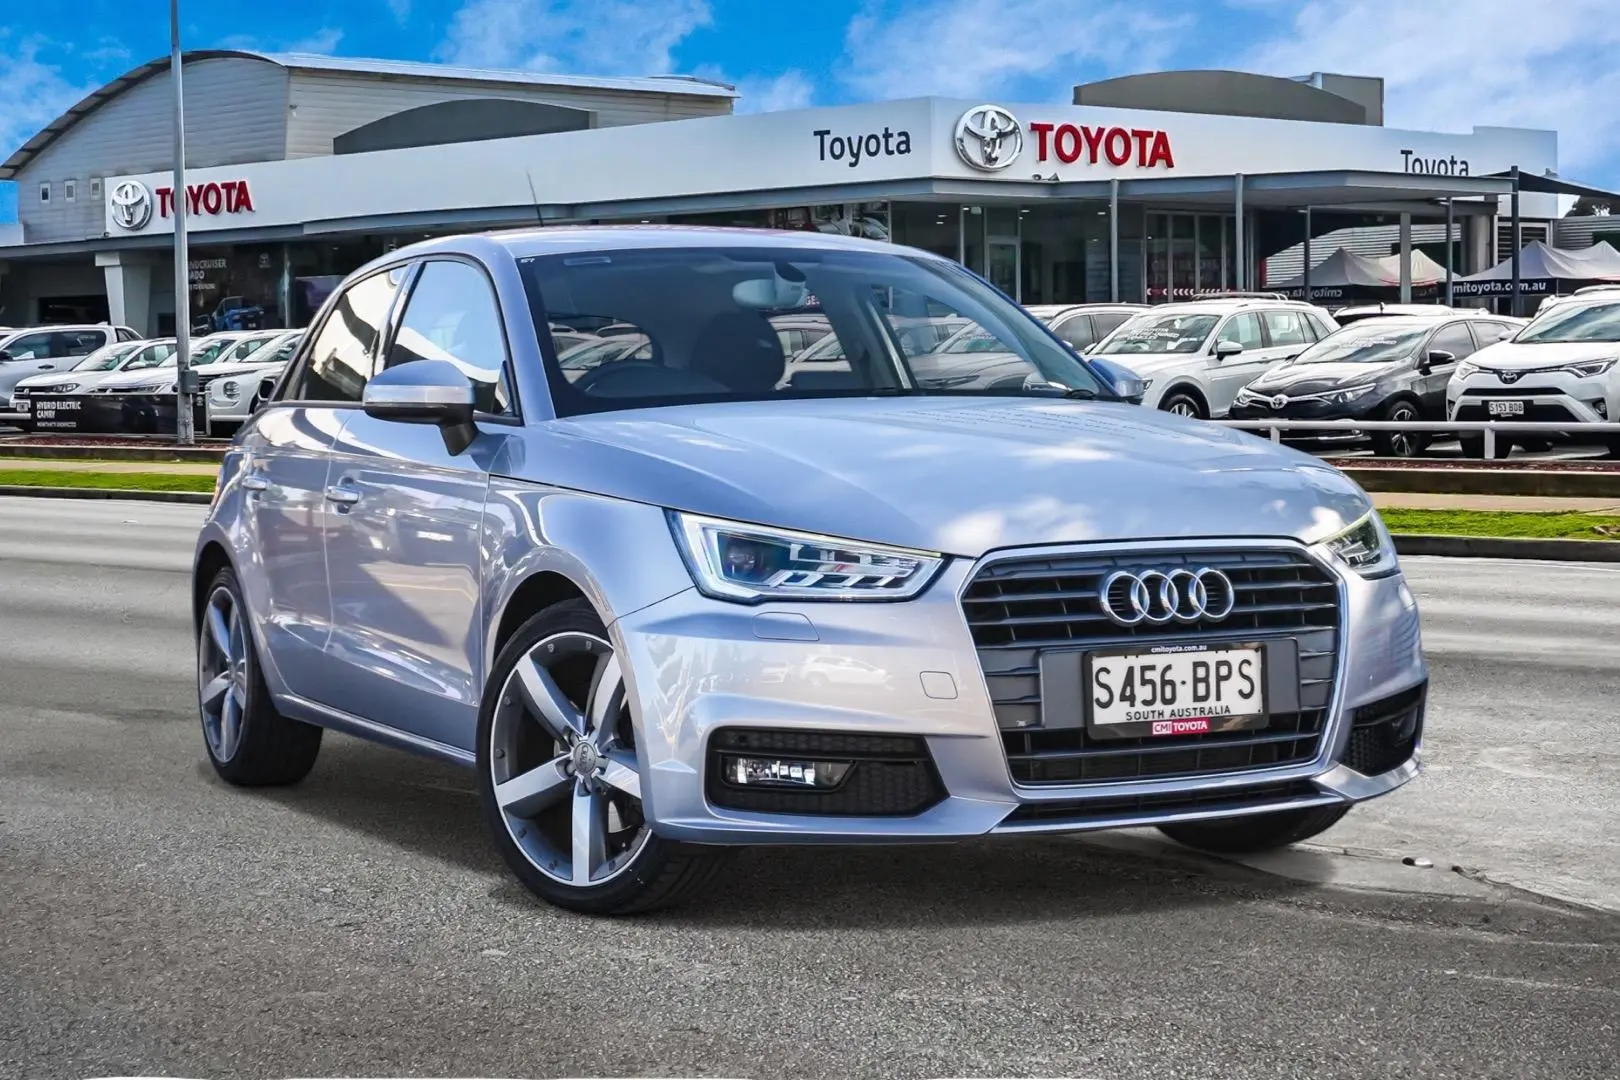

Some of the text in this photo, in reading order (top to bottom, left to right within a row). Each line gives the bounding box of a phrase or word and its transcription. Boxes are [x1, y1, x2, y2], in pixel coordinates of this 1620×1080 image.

[813, 127, 912, 168] Toyota
[1030, 122, 1174, 169] TOYOTA
[57, 401, 81, 410] ELECTRIC
[1151, 644, 1207, 654] cmitoyota.com.au
[1126, 705, 1231, 721] SOUTH AUSTRALIA
[1154, 721, 1208, 733] CMI TOYOTA
